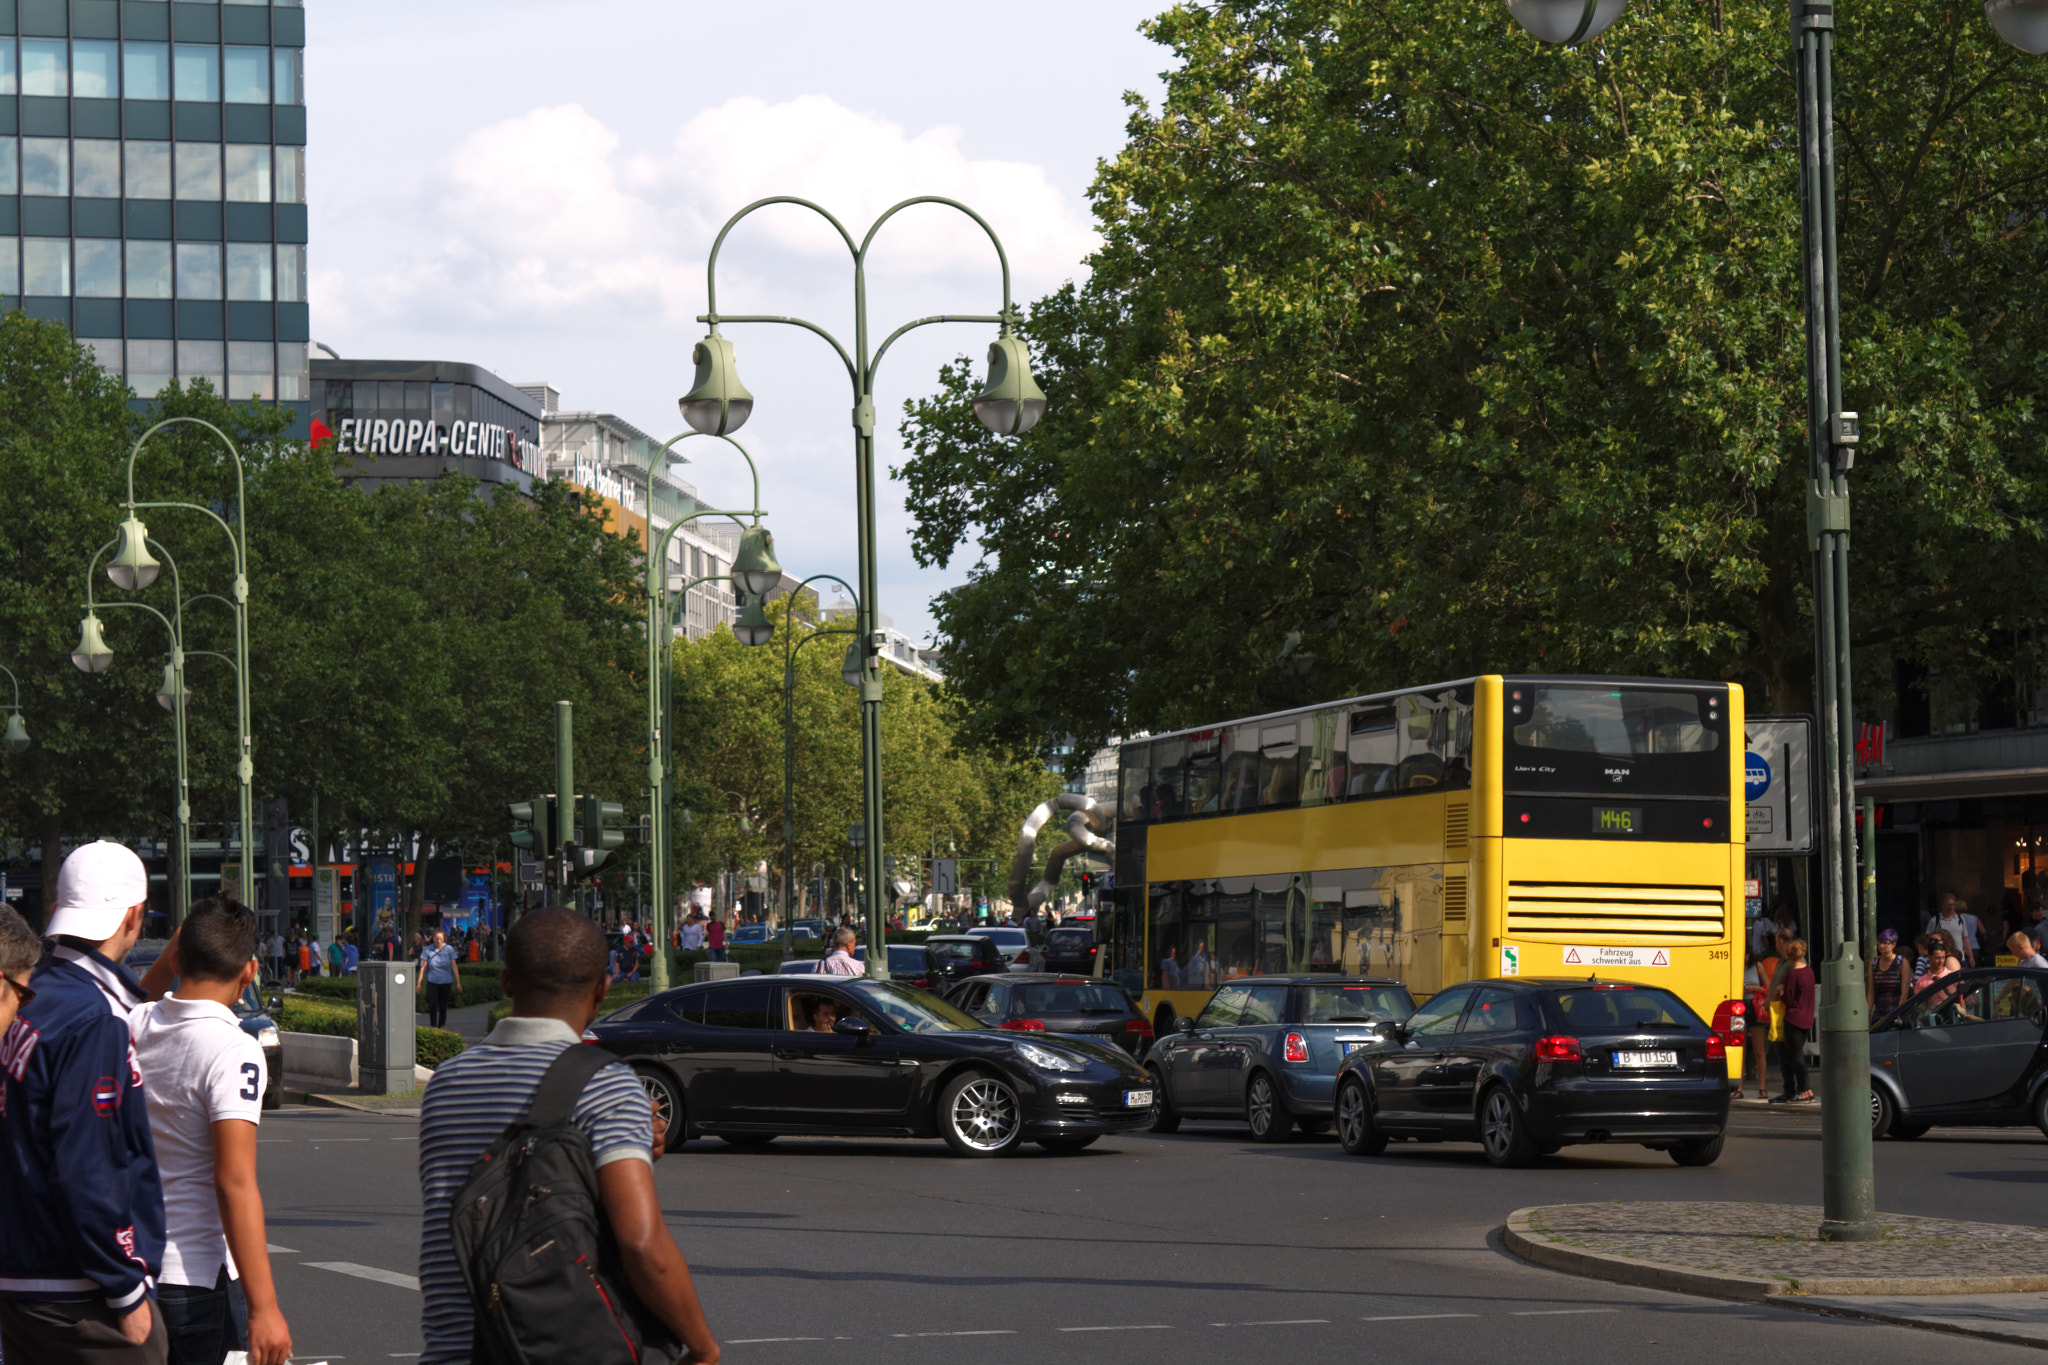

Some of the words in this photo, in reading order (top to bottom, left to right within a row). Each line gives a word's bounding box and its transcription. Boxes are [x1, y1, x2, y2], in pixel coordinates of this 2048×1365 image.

[337, 418, 505, 459] EUROPA-CENTER
[1604, 768, 1630, 776] MAN
[1601, 810, 1632, 829] M46
[1600, 948, 1634, 958] Fahrzeug
[1708, 950, 1729, 960] 3419
[1591, 957, 1627, 965] schwenkt
[0, 1016, 40, 1082] SIA
[1623, 1051, 1631, 1063] B
[240, 1062, 260, 1101] 3
